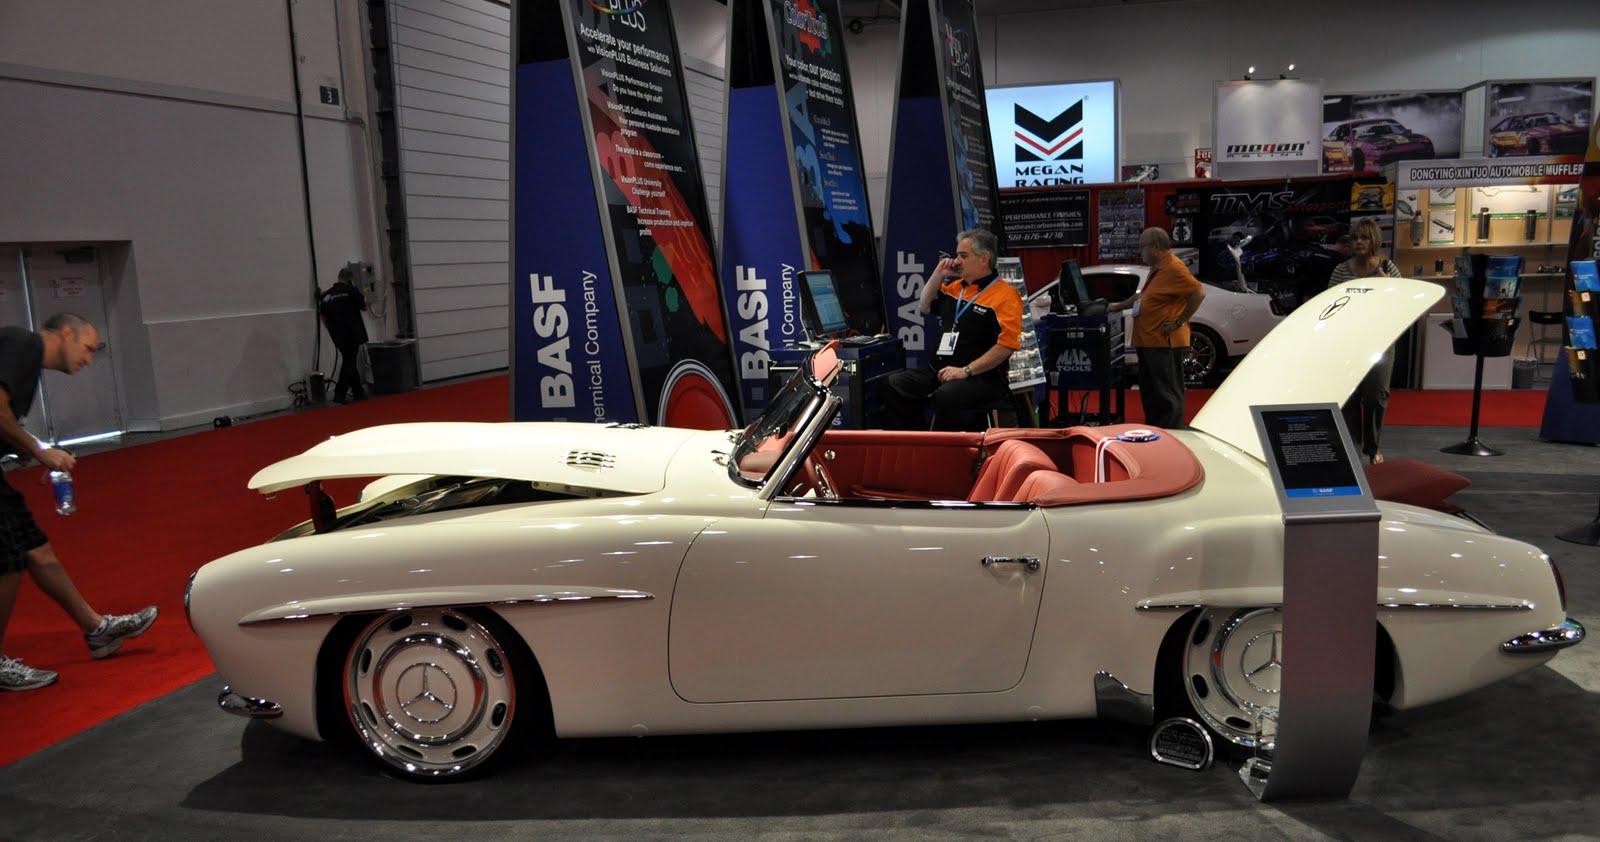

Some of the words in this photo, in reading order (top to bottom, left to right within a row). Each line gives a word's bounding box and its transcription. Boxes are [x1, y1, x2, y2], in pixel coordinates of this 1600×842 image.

[580, 23, 616, 46] Accelerate
[617, 38, 632, 51] your
[633, 44, 670, 64] performance
[595, 45, 627, 63] VisionPLUS
[627, 55, 649, 71] Business
[649, 62, 672, 78] Solutions
[785, 53, 797, 67] Your
[809, 63, 819, 76] our
[819, 67, 841, 83] passion
[601, 68, 625, 82] VisionPLUS
[625, 75, 649, 89] Performance
[649, 82, 663, 92] Groups
[327, 90, 333, 103] 3
[613, 83, 619, 92] Do
[619, 86, 627, 95] you
[627, 88, 637, 97] have
[643, 91, 653, 102] right
[607, 101, 631, 113] VisionPLUS
[630, 107, 647, 118] Collision
[647, 111, 667, 122] Assistance
[619, 116, 629, 126] Your
[628, 119, 646, 129] personal
[620, 128, 638, 137] program
[615, 144, 623, 153] The
[623, 147, 634, 155] world
[644, 161, 655, 169] come
[655, 162, 674, 171] experience
[1015, 164, 1084, 177] MEGAN
[1411, 167, 1455, 181] DONGYING
[1456, 166, 1488, 179] XINTUO
[1489, 164, 1544, 178] AUTOMOBILE
[1545, 163, 1584, 176] MUFFLER
[621, 175, 643, 186] VisionPLUS
[644, 178, 662, 189] University
[1015, 176, 1084, 188] RACING
[631, 187, 651, 198] Challenge
[651, 190, 666, 198] yourself
[626, 205, 638, 213] BASF
[638, 206, 656, 215] Technical
[656, 208, 671, 217] Training
[1210, 191, 1294, 215] TMS
[1005, 212, 1052, 221] PERFORMANCE
[1053, 210, 1082, 219] FINISHES
[781, 263, 795, 336] Company
[897, 250, 925, 351] BASF
[582, 270, 600, 356] Company
[736, 265, 770, 379] BASF
[529, 273, 576, 408] BASF
[1056, 348, 1092, 365] MAC
[586, 360, 605, 424] emical
